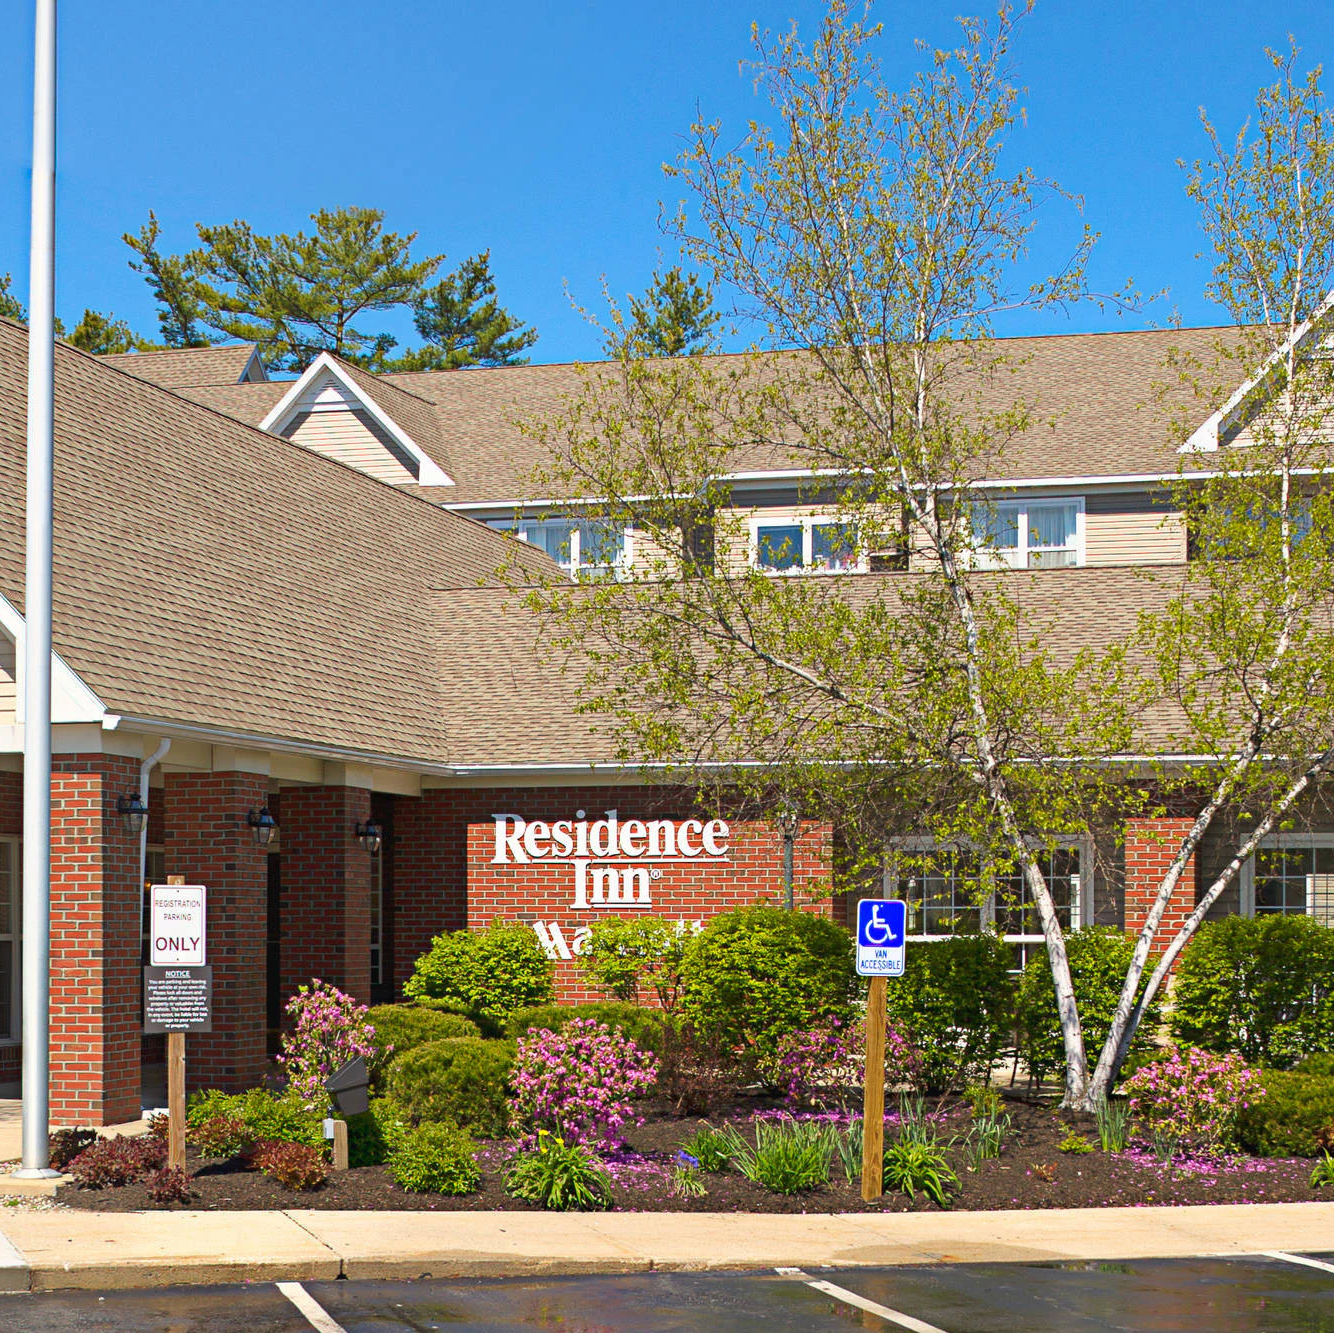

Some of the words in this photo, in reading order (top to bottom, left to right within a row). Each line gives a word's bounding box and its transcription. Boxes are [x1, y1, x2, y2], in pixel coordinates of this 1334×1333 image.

[491, 809, 730, 865] Residence
[569, 858, 652, 909] Inn
[155, 900, 201, 908] REGISTRATION
[156, 937, 200, 951] ONLY
[875, 949, 887, 958] VAN
[860, 960, 900, 970] ACCESSIBLE
